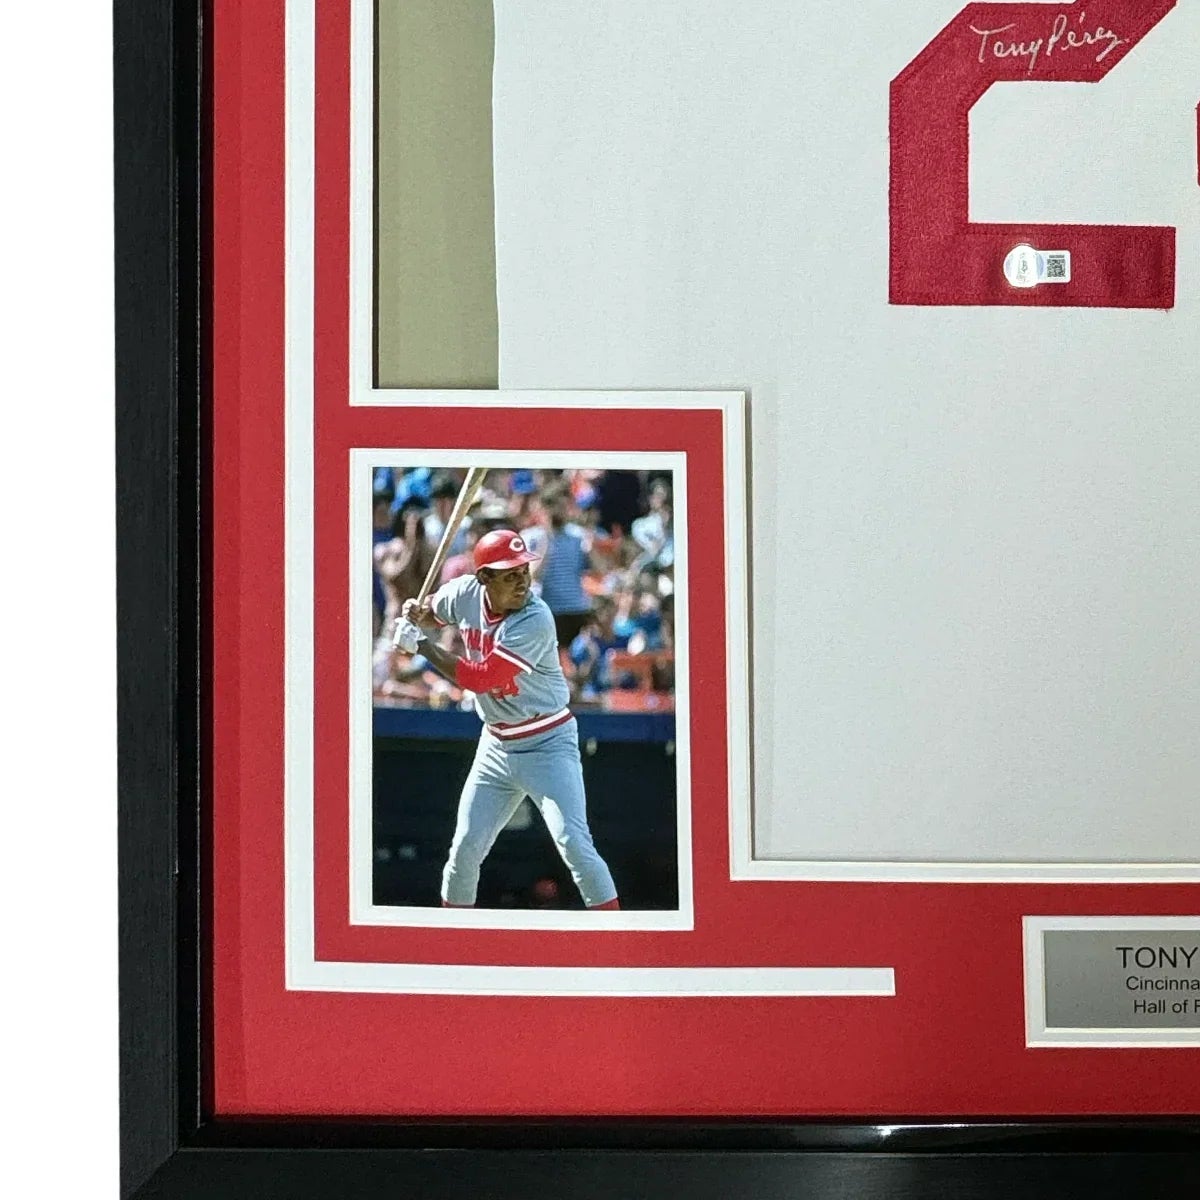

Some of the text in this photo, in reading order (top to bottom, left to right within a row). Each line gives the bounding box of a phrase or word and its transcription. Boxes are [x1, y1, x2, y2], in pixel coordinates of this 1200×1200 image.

[968, 22, 1043, 76] Tony
[1115, 946, 1199, 969] TONY
[1133, 999, 1166, 1014] Hall
[1171, 999, 1189, 1014] of
